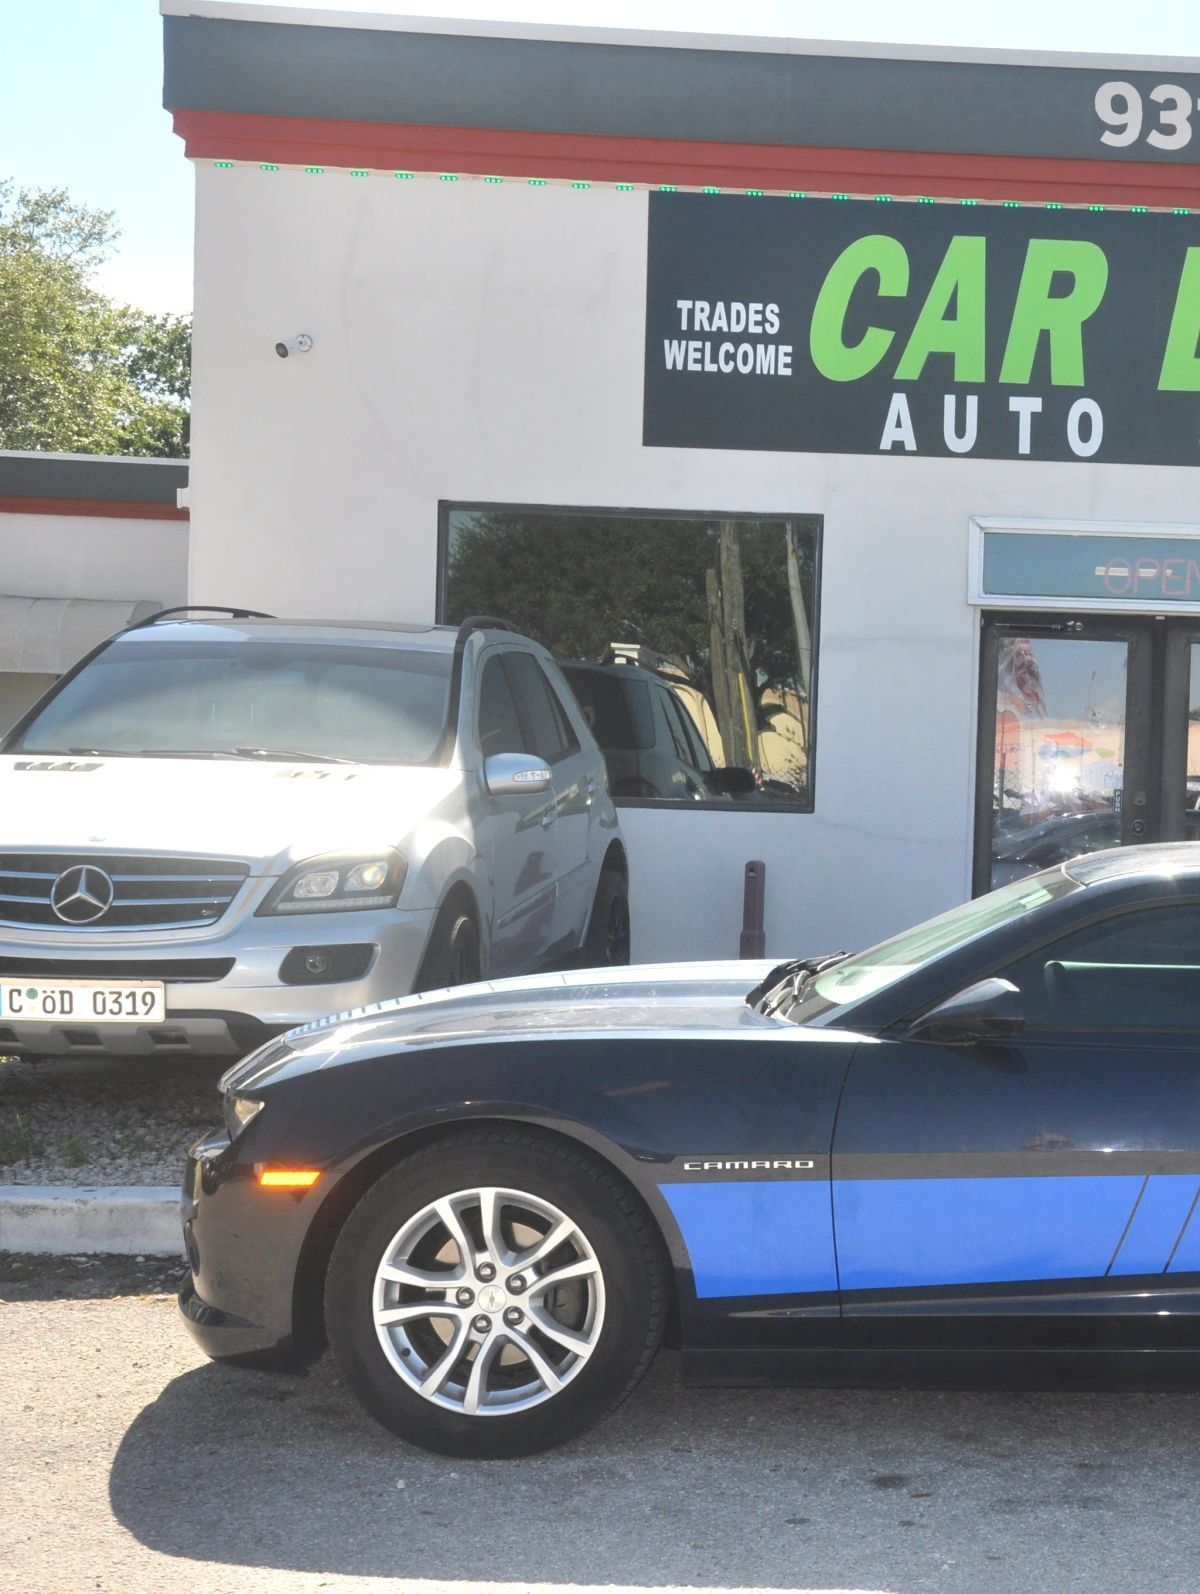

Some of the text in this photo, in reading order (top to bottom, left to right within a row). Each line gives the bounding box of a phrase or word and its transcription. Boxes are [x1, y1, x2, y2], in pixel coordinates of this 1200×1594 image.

[677, 300, 780, 334] TRADES
[809, 234, 1108, 386] CAR
[664, 340, 793, 376] WELCOME
[879, 393, 1103, 457] AUTO
[8, 988, 23, 1013] C
[92, 990, 156, 1016] 0319
[684, 1160, 814, 1171] CAMARO
